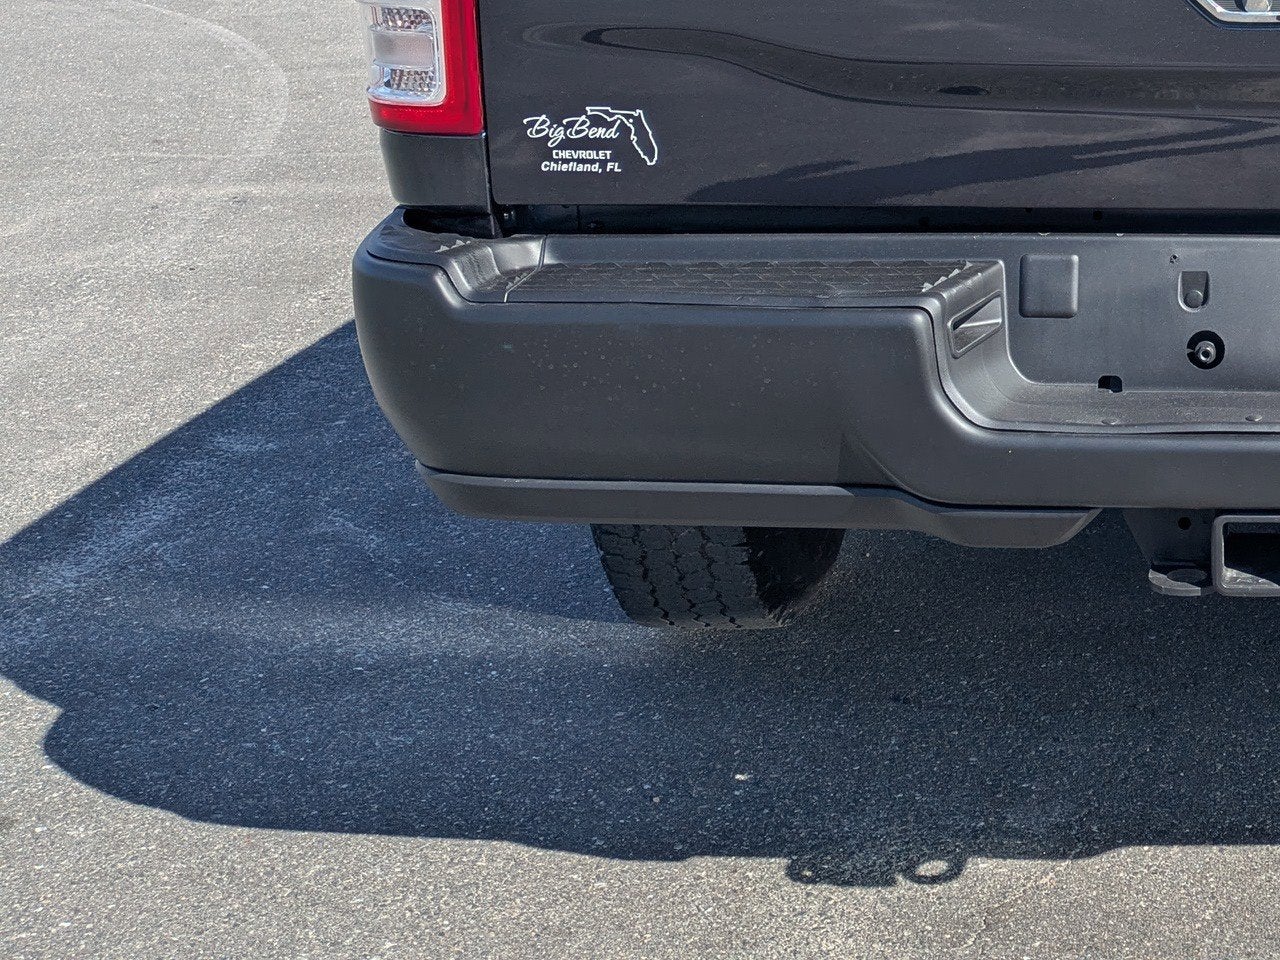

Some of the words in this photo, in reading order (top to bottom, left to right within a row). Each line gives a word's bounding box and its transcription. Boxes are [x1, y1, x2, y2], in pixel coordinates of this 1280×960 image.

[523, 114, 566, 147] Big
[562, 114, 621, 139] Bend
[552, 150, 612, 160] CHEVROLET
[541, 161, 602, 174] Chiefland,
[606, 162, 622, 172] FL
